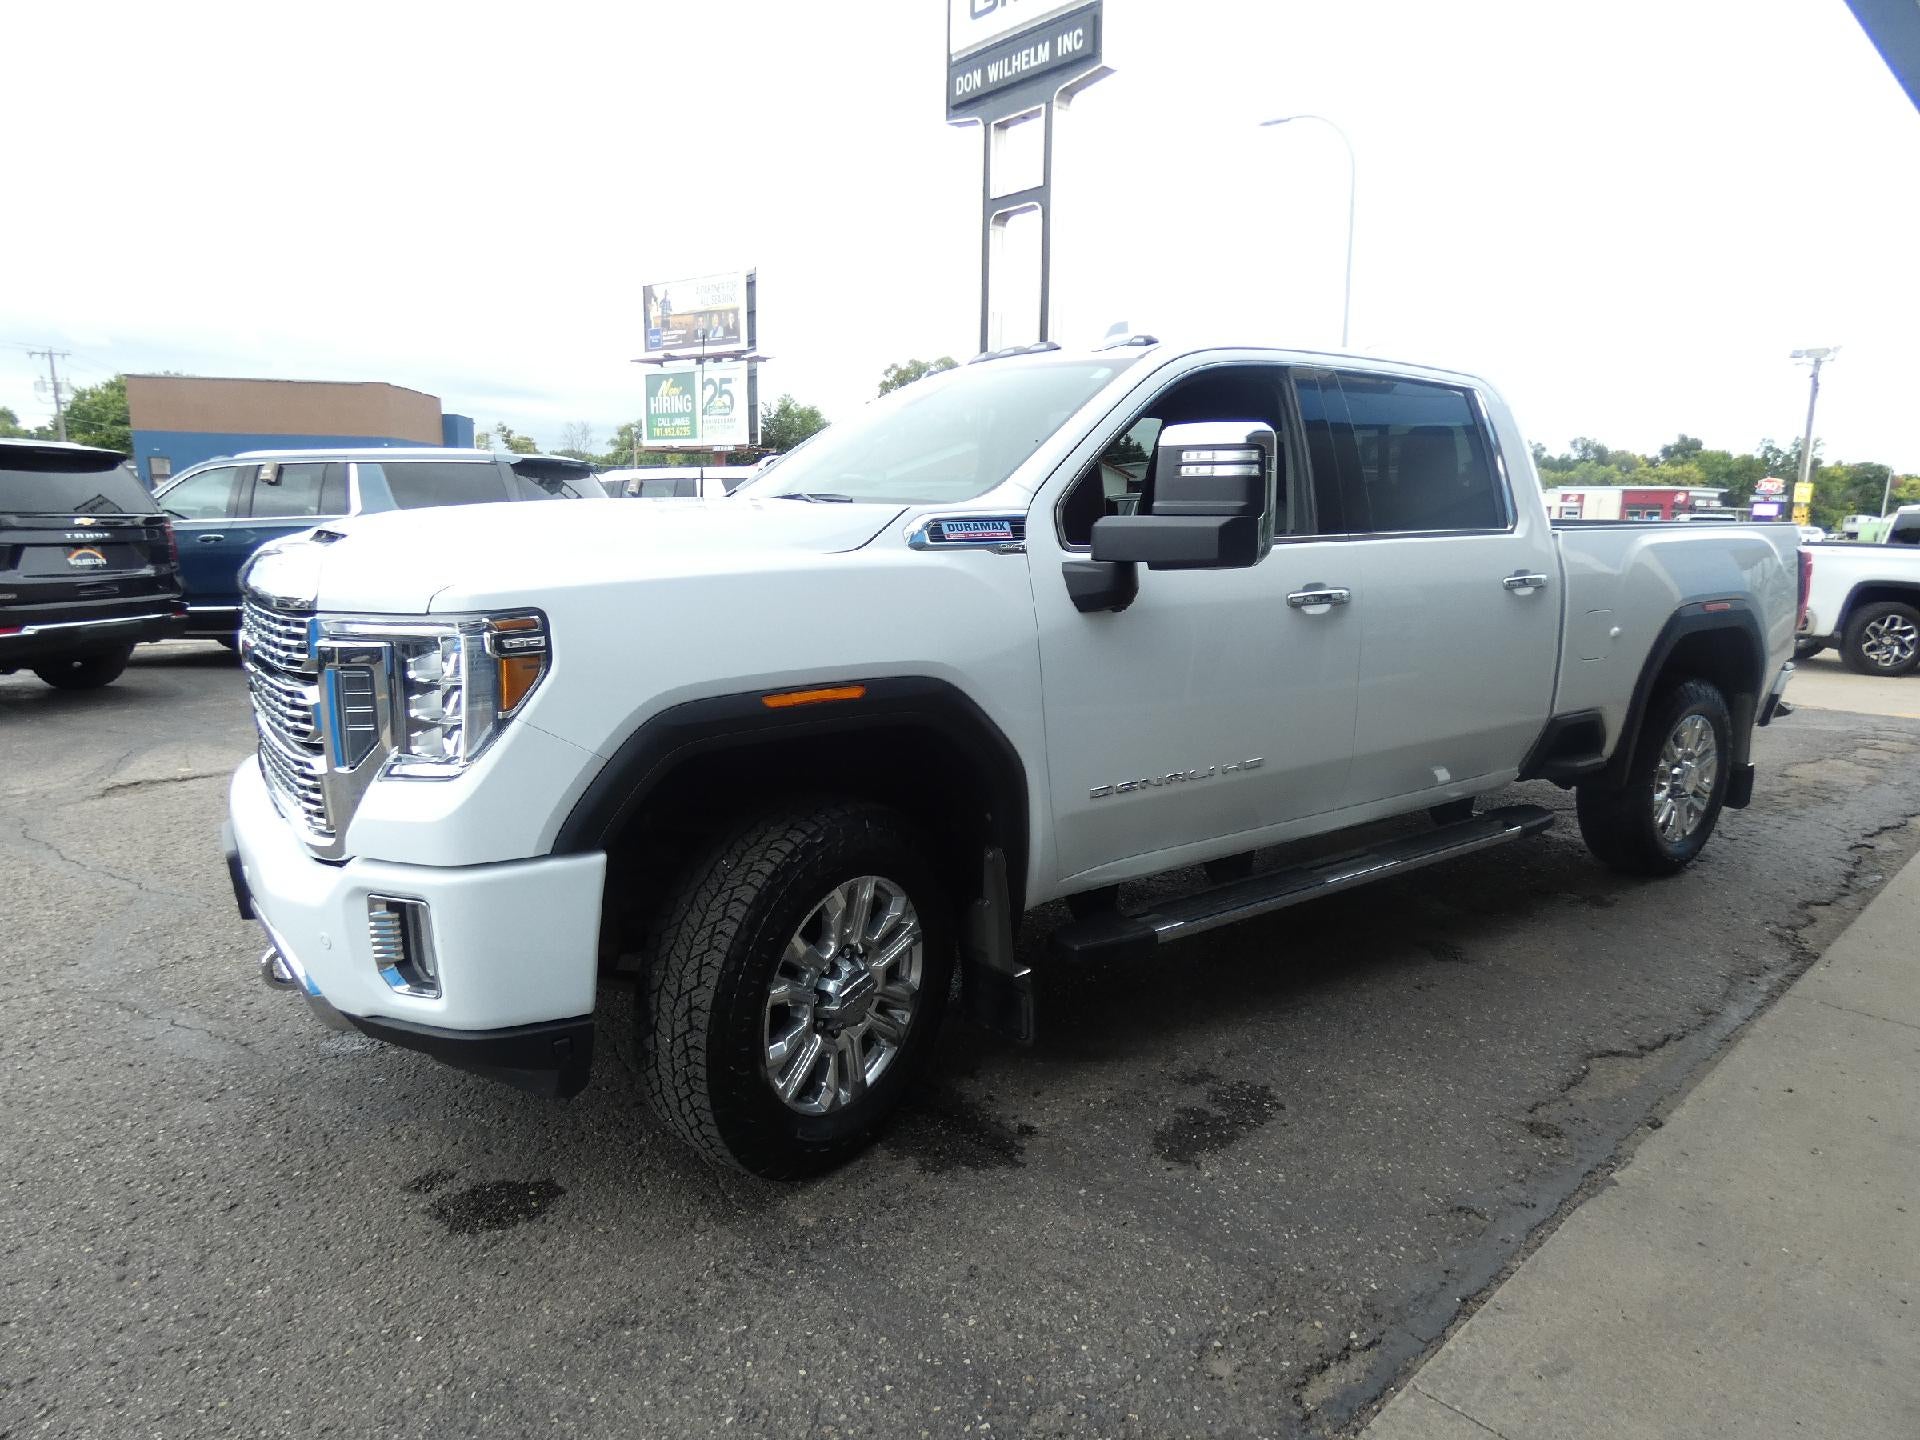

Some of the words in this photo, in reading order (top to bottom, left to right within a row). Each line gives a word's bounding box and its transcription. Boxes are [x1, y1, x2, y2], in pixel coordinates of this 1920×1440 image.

[956, 69, 981, 95] DON
[988, 41, 1050, 83] WILHELM
[1057, 27, 1083, 57] INC
[650, 393, 692, 415] HIRING
[657, 417, 671, 427] CALL
[947, 522, 1006, 532] DURAMAX
